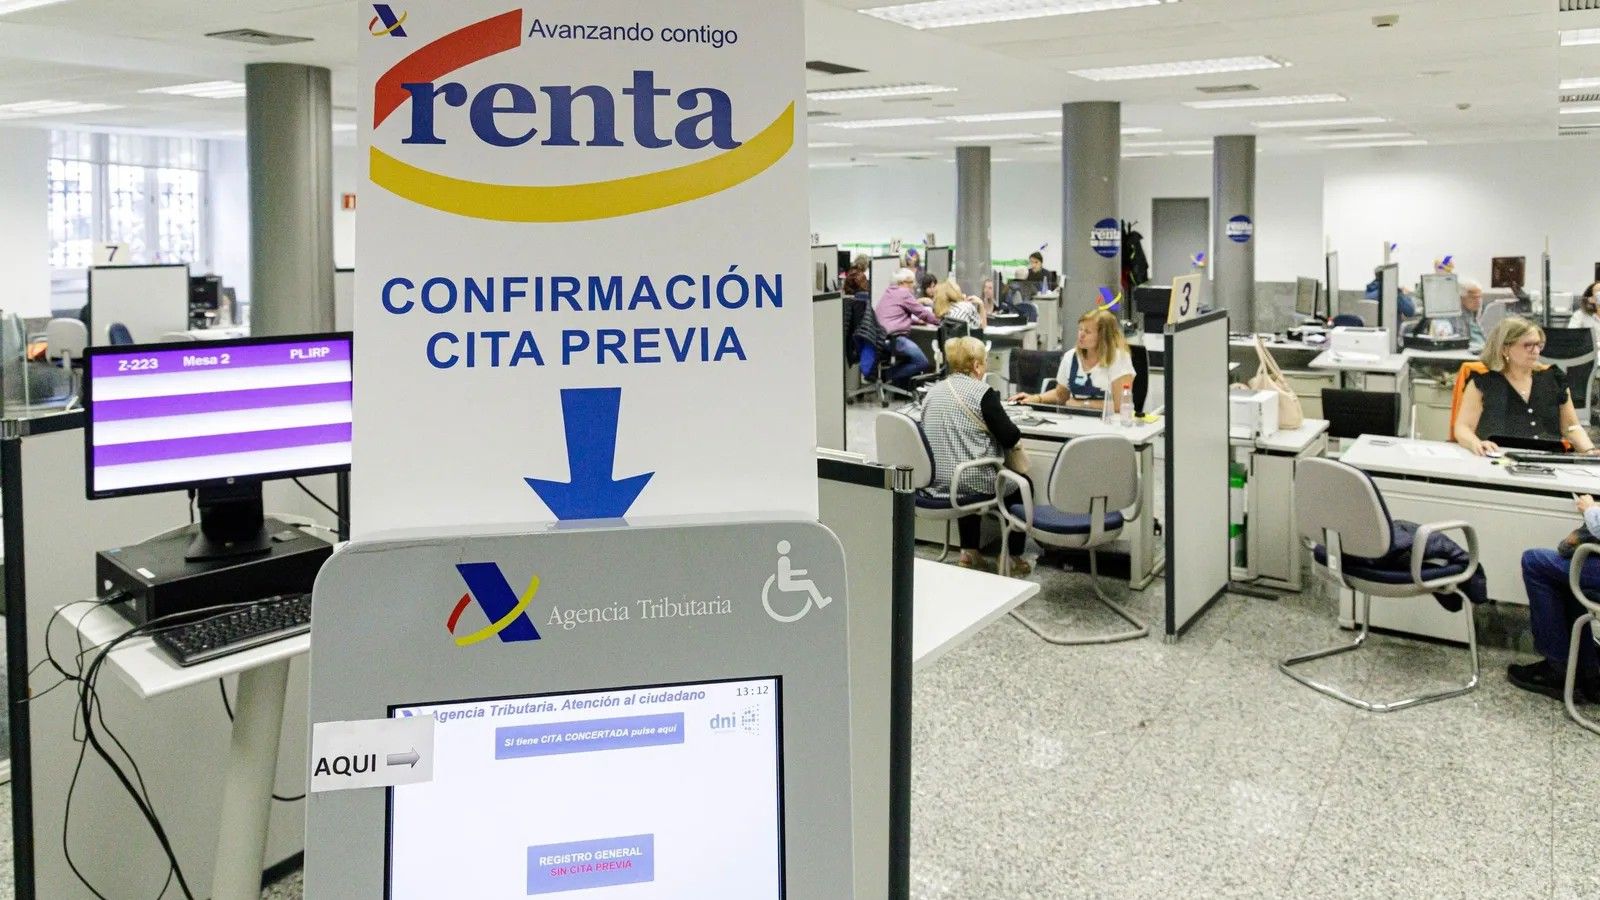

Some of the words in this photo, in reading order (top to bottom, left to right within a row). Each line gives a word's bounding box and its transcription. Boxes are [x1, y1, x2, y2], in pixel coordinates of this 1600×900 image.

[529, 19, 654, 42] Avanzando
[661, 25, 738, 48] contigo
[401, 70, 742, 150] renta
[106, 246, 118, 262] 7
[381, 264, 784, 315] CONFIRMACIÓN
[1180, 282, 1191, 316] 3
[426, 330, 545, 369] CITA
[562, 326, 747, 366] PREVIA
[118, 357, 159, 372] Z-223
[183, 355, 218, 367] Mesa
[221, 353, 231, 365] 2
[547, 602, 630, 630] Agencia
[637, 595, 732, 619] Tributaria
[737, 685, 770, 697] 13:12
[432, 706, 485, 723] Agencia
[490, 701, 558, 717] Tributaria.
[561, 695, 620, 712] Atención
[623, 693, 636, 706] al
[639, 690, 706, 705] ciudadano
[710, 711, 737, 730] dni
[516, 736, 538, 746] tiene
[541, 733, 563, 744] CITA
[565, 728, 629, 742] CONCERTADA
[631, 726, 656, 738] pulse
[314, 753, 377, 778] AQUI
[539, 852, 592, 867] REGISTRO
[595, 846, 643, 860] GENERAL
[549, 867, 567, 877] SIN
[570, 863, 593, 875] CITA
[596, 860, 633, 872] PREVIA
